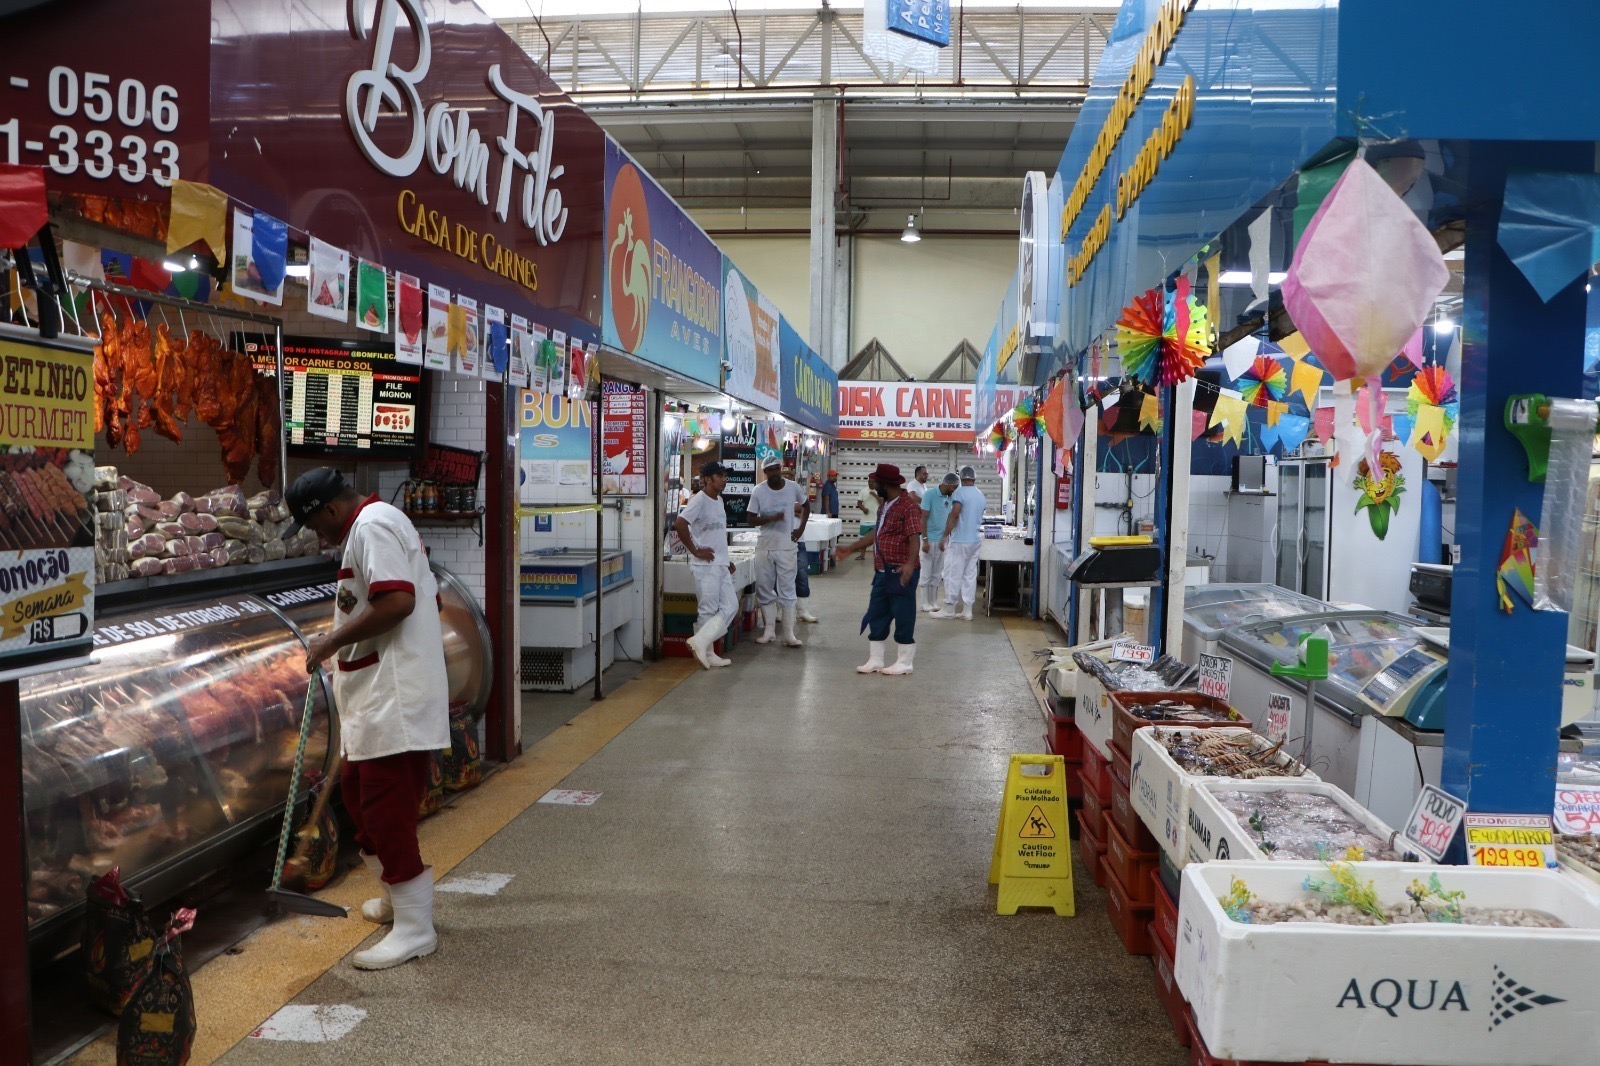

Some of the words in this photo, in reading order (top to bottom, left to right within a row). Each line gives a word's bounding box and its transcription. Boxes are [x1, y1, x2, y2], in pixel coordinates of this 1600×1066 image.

[918, 0, 930, 29] Pe
[48, 65, 180, 133] 0506
[346, 0, 489, 205] Bom
[489, 64, 568, 246] Filé
[398, 190, 451, 252] CASA
[456, 223, 478, 263] DE
[481, 233, 538, 291] CARNES
[653, 239, 720, 337] FRANGOBOM
[670, 321, 711, 355] AVES
[308, 347, 349, 356] INSTAGRAM
[258, 355, 299, 366] MELOR
[301, 357, 335, 368] CARNE
[337, 360, 351, 369] DO
[353, 362, 372, 371] SOL
[379, 391, 412, 399] MIGNON
[385, 382, 402, 390] FILE
[603, 381, 640, 394] RANGO
[838, 386, 885, 417] DISK
[896, 388, 972, 419] CARNE
[861, 430, 934, 440] 3452-4706
[928, 421, 971, 429] PEIXES
[724, 434, 755, 445] SALMÃO
[520, 573, 577, 584] ANGOBOM
[266, 585, 325, 606] CARNES
[12, 590, 74, 624] Semana
[33, 617, 51, 640] R$
[100, 625, 134, 642] DE
[124, 619, 160, 637] SOL
[155, 615, 187, 631] DE
[181, 602, 241, 626] ITORORÓ
[241, 600, 267, 614] BA
[1201, 669, 1226, 681] LAGOSTA
[1220, 661, 1229, 671] DE
[1425, 793, 1457, 823] POLVO
[1188, 807, 1212, 852] BLUMAR
[1469, 817, 1547, 826] PROMOÇÃO
[1035, 850, 1056, 858] Floor
[1336, 978, 1470, 1017] AQUA
